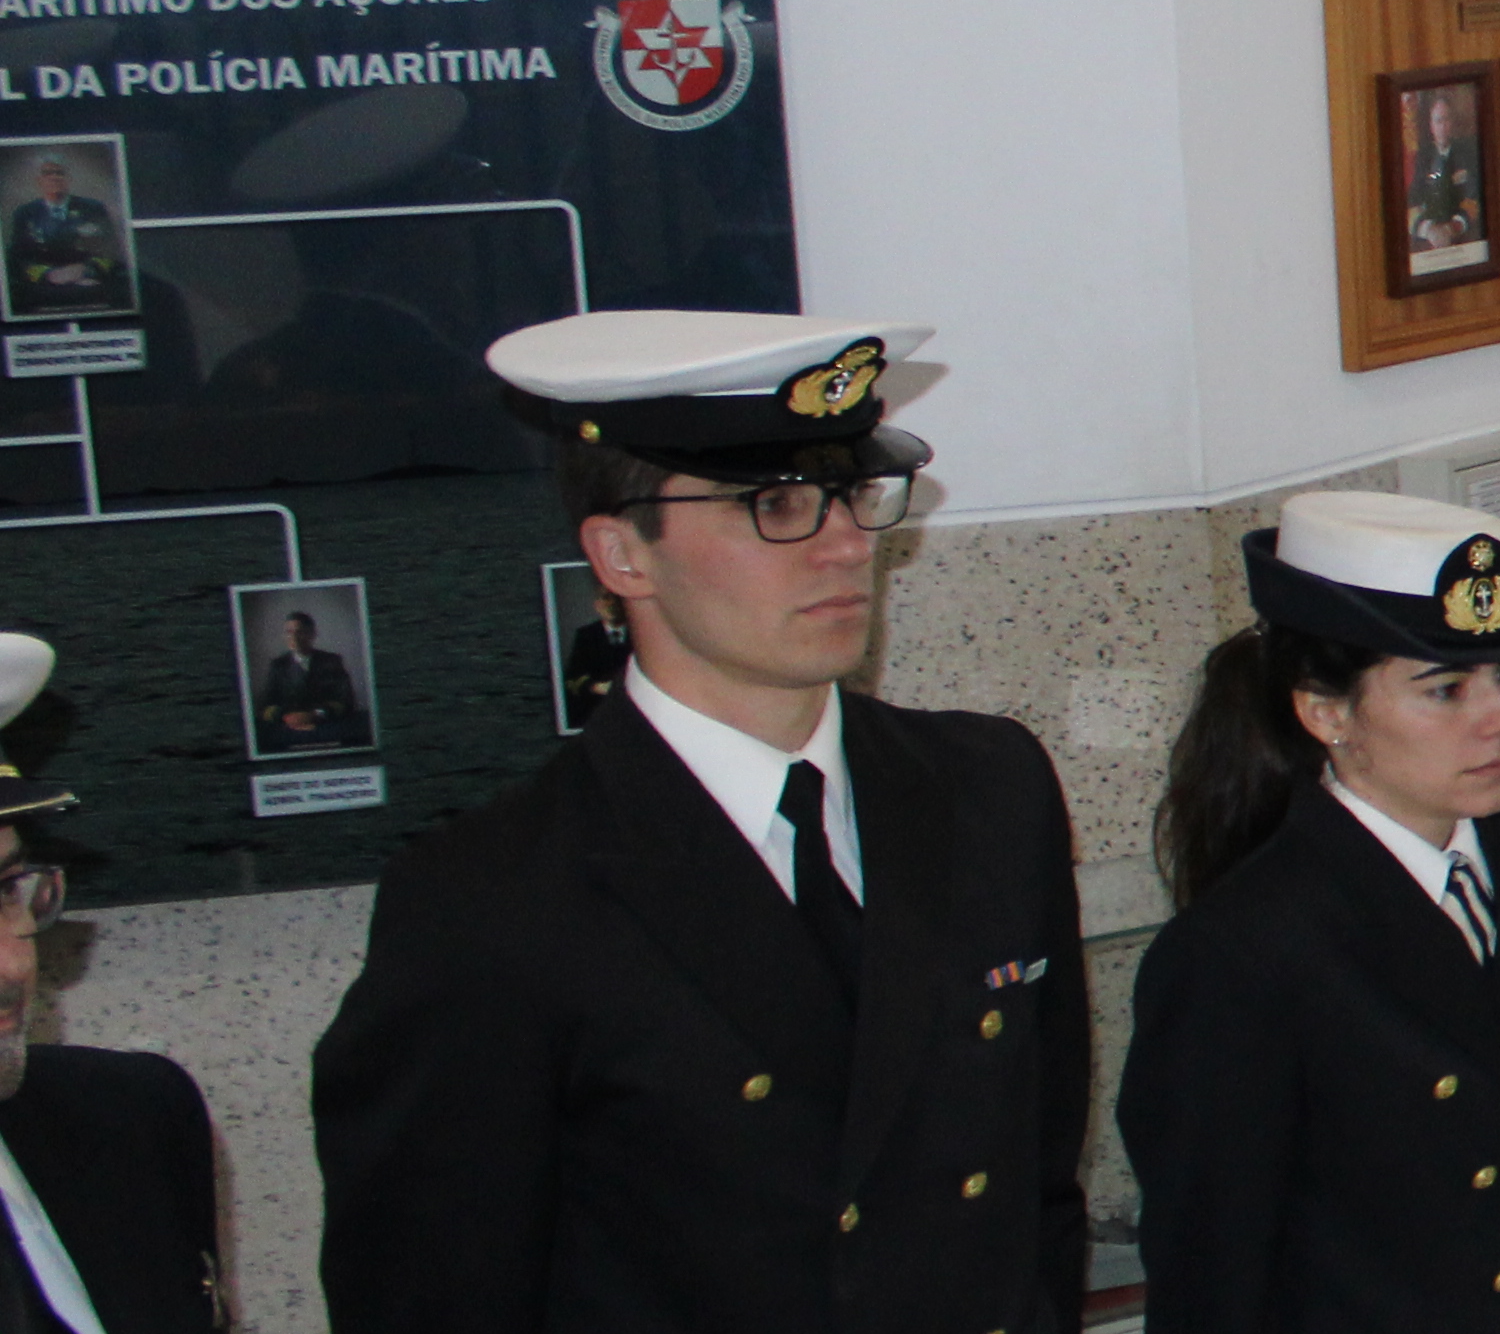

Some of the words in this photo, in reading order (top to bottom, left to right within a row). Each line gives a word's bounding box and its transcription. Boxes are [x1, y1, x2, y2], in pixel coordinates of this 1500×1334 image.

[37, 64, 106, 100] DA
[116, 49, 307, 96] POLÍCIA
[316, 41, 558, 88] MARÍTIMA
